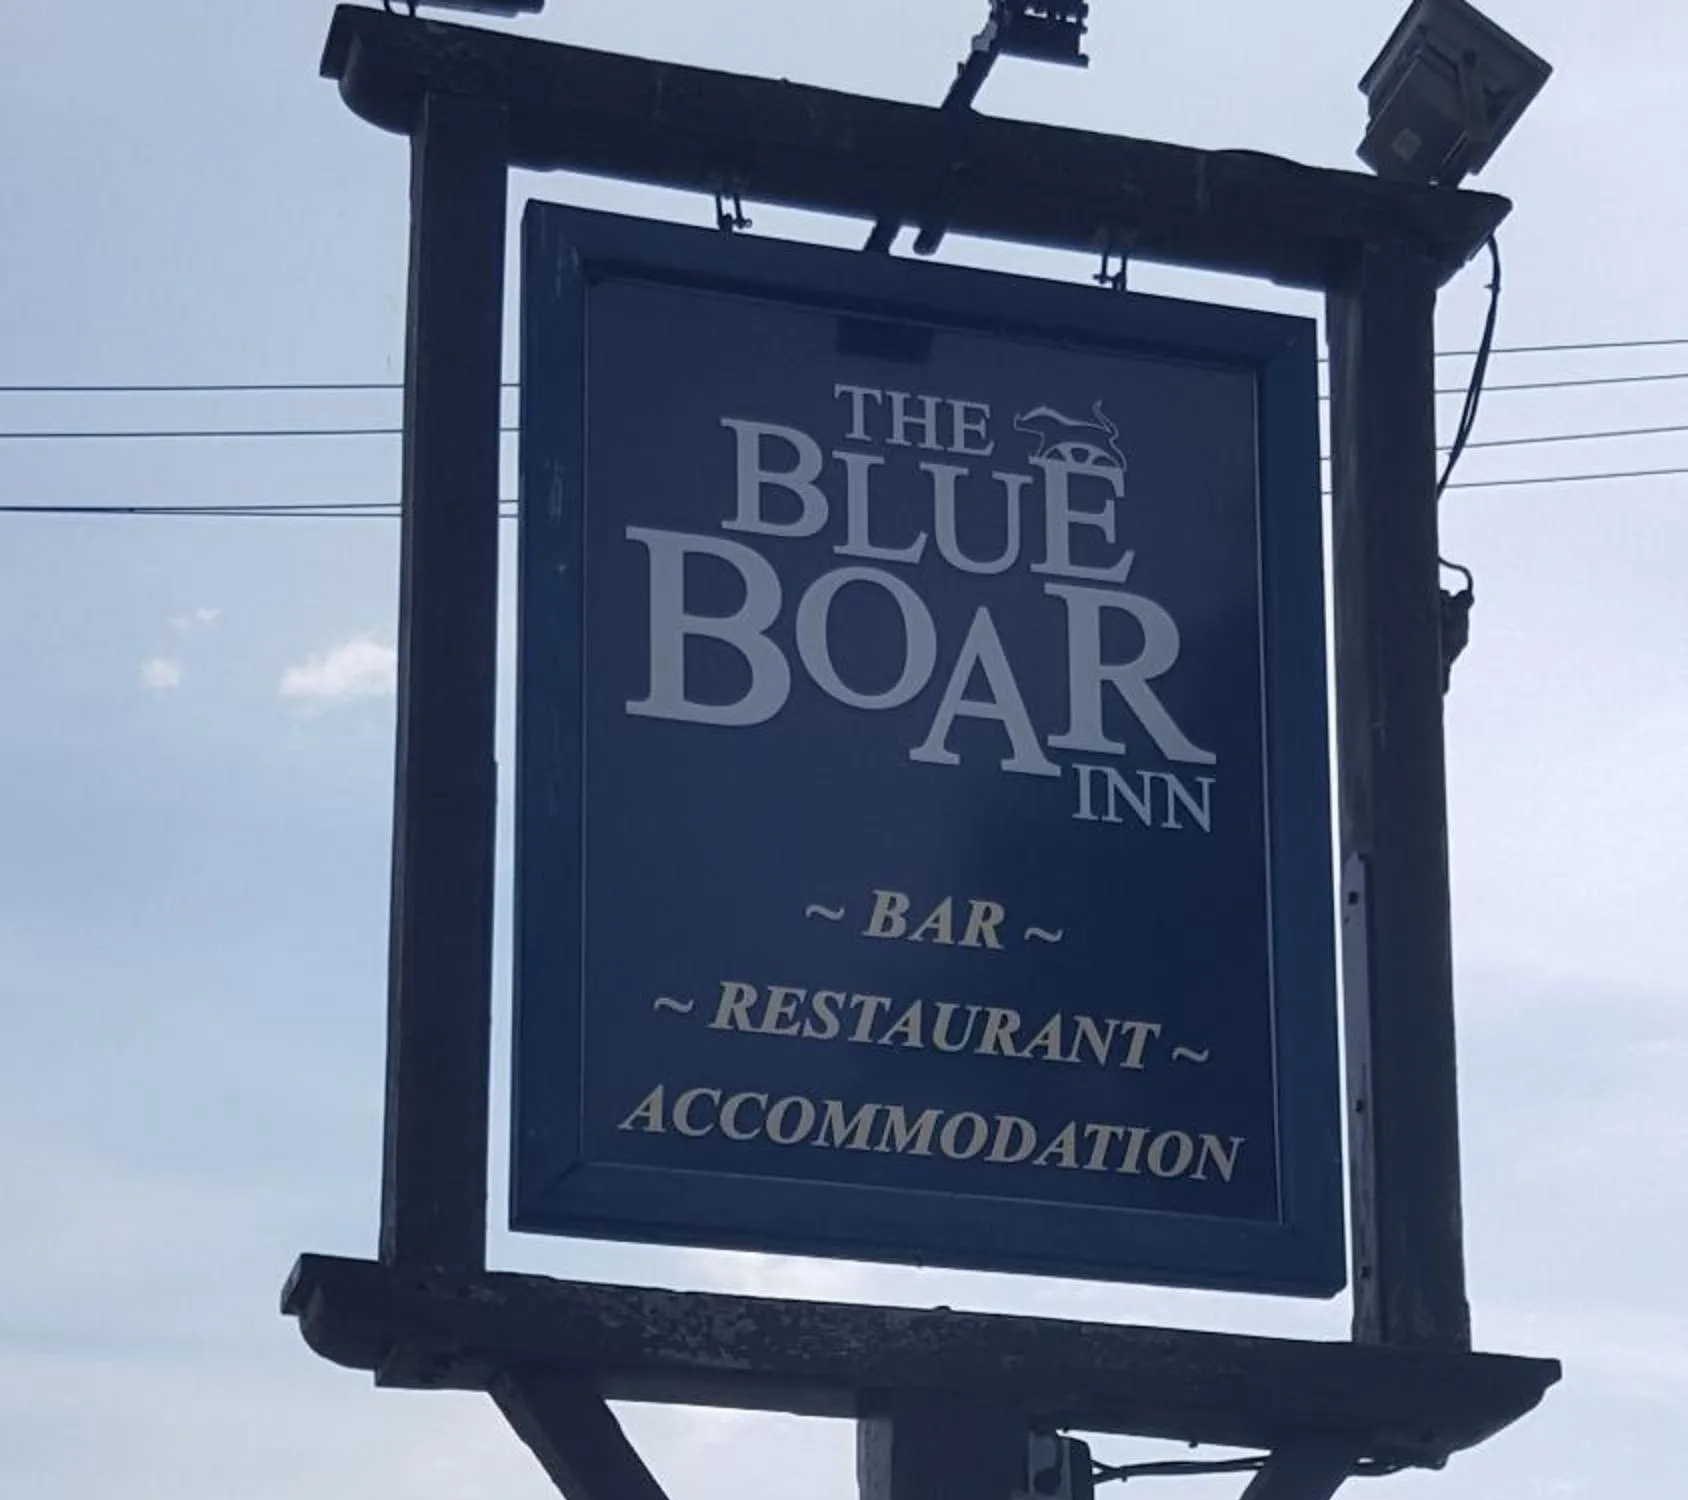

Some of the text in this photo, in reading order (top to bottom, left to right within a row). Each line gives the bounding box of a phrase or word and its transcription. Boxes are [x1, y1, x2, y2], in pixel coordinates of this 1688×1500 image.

[834, 384, 995, 456] THE
[720, 417, 1136, 583] BLUE
[625, 526, 1217, 777] BOAR
[1072, 764, 1217, 833] INN
[862, 889, 1005, 949] BAR
[708, 980, 1162, 1069] RESTAURANT
[618, 1084, 1245, 1182] ACCOMMODATION
